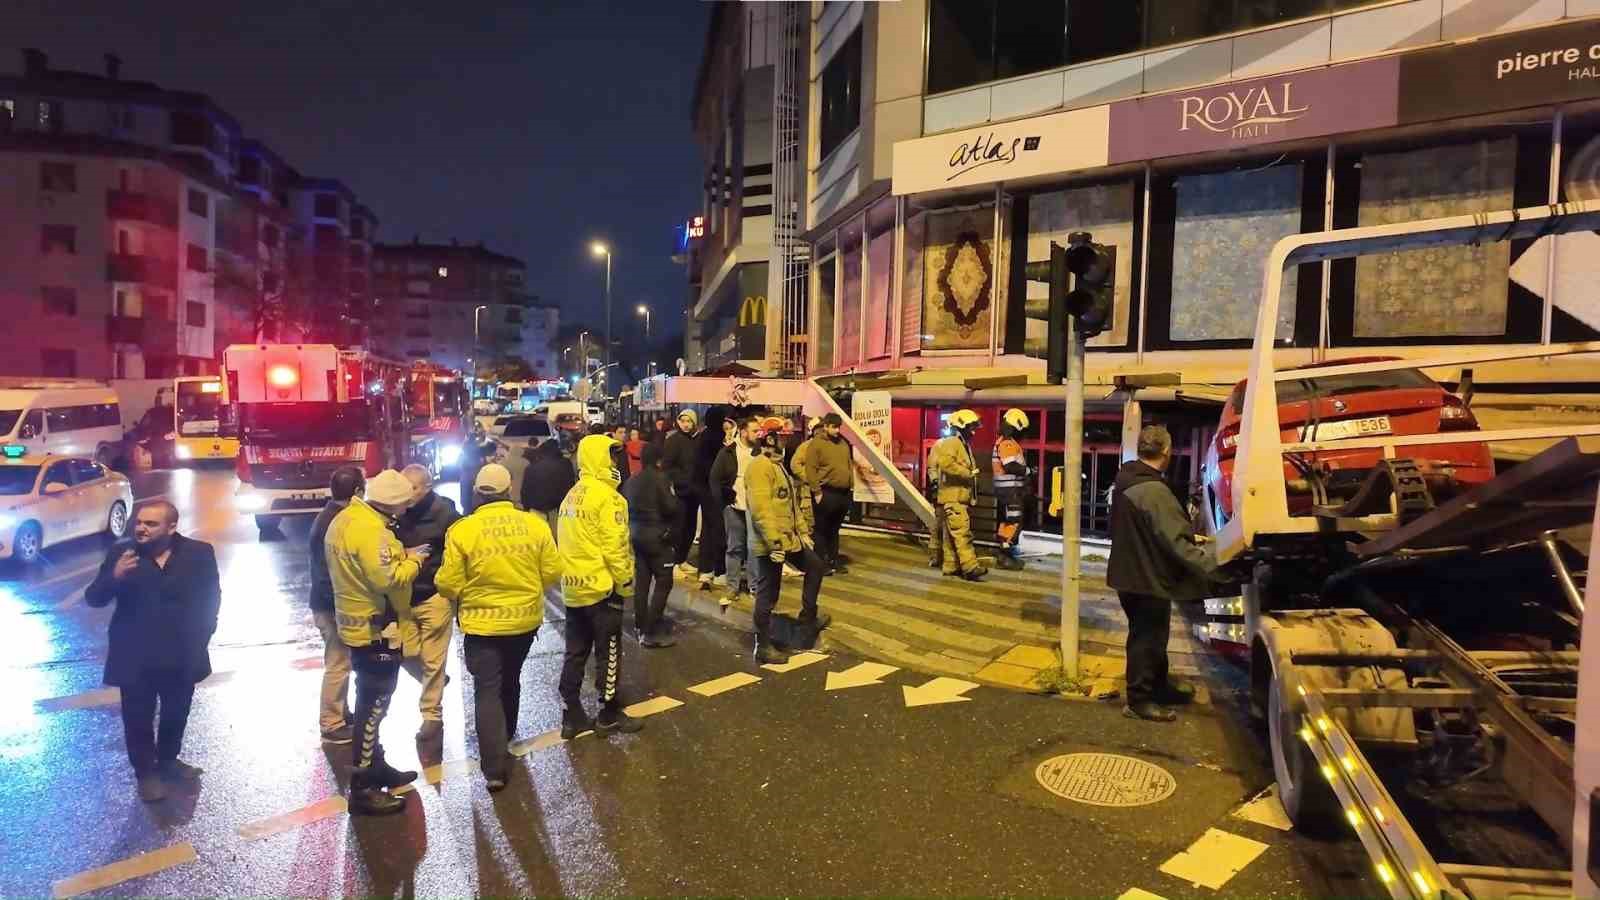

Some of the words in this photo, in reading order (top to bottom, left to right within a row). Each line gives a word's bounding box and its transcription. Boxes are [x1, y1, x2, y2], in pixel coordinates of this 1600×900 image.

[1497, 47, 1580, 79] pierre
[1177, 82, 1311, 133] ROYAL
[948, 132, 1021, 171] atlas
